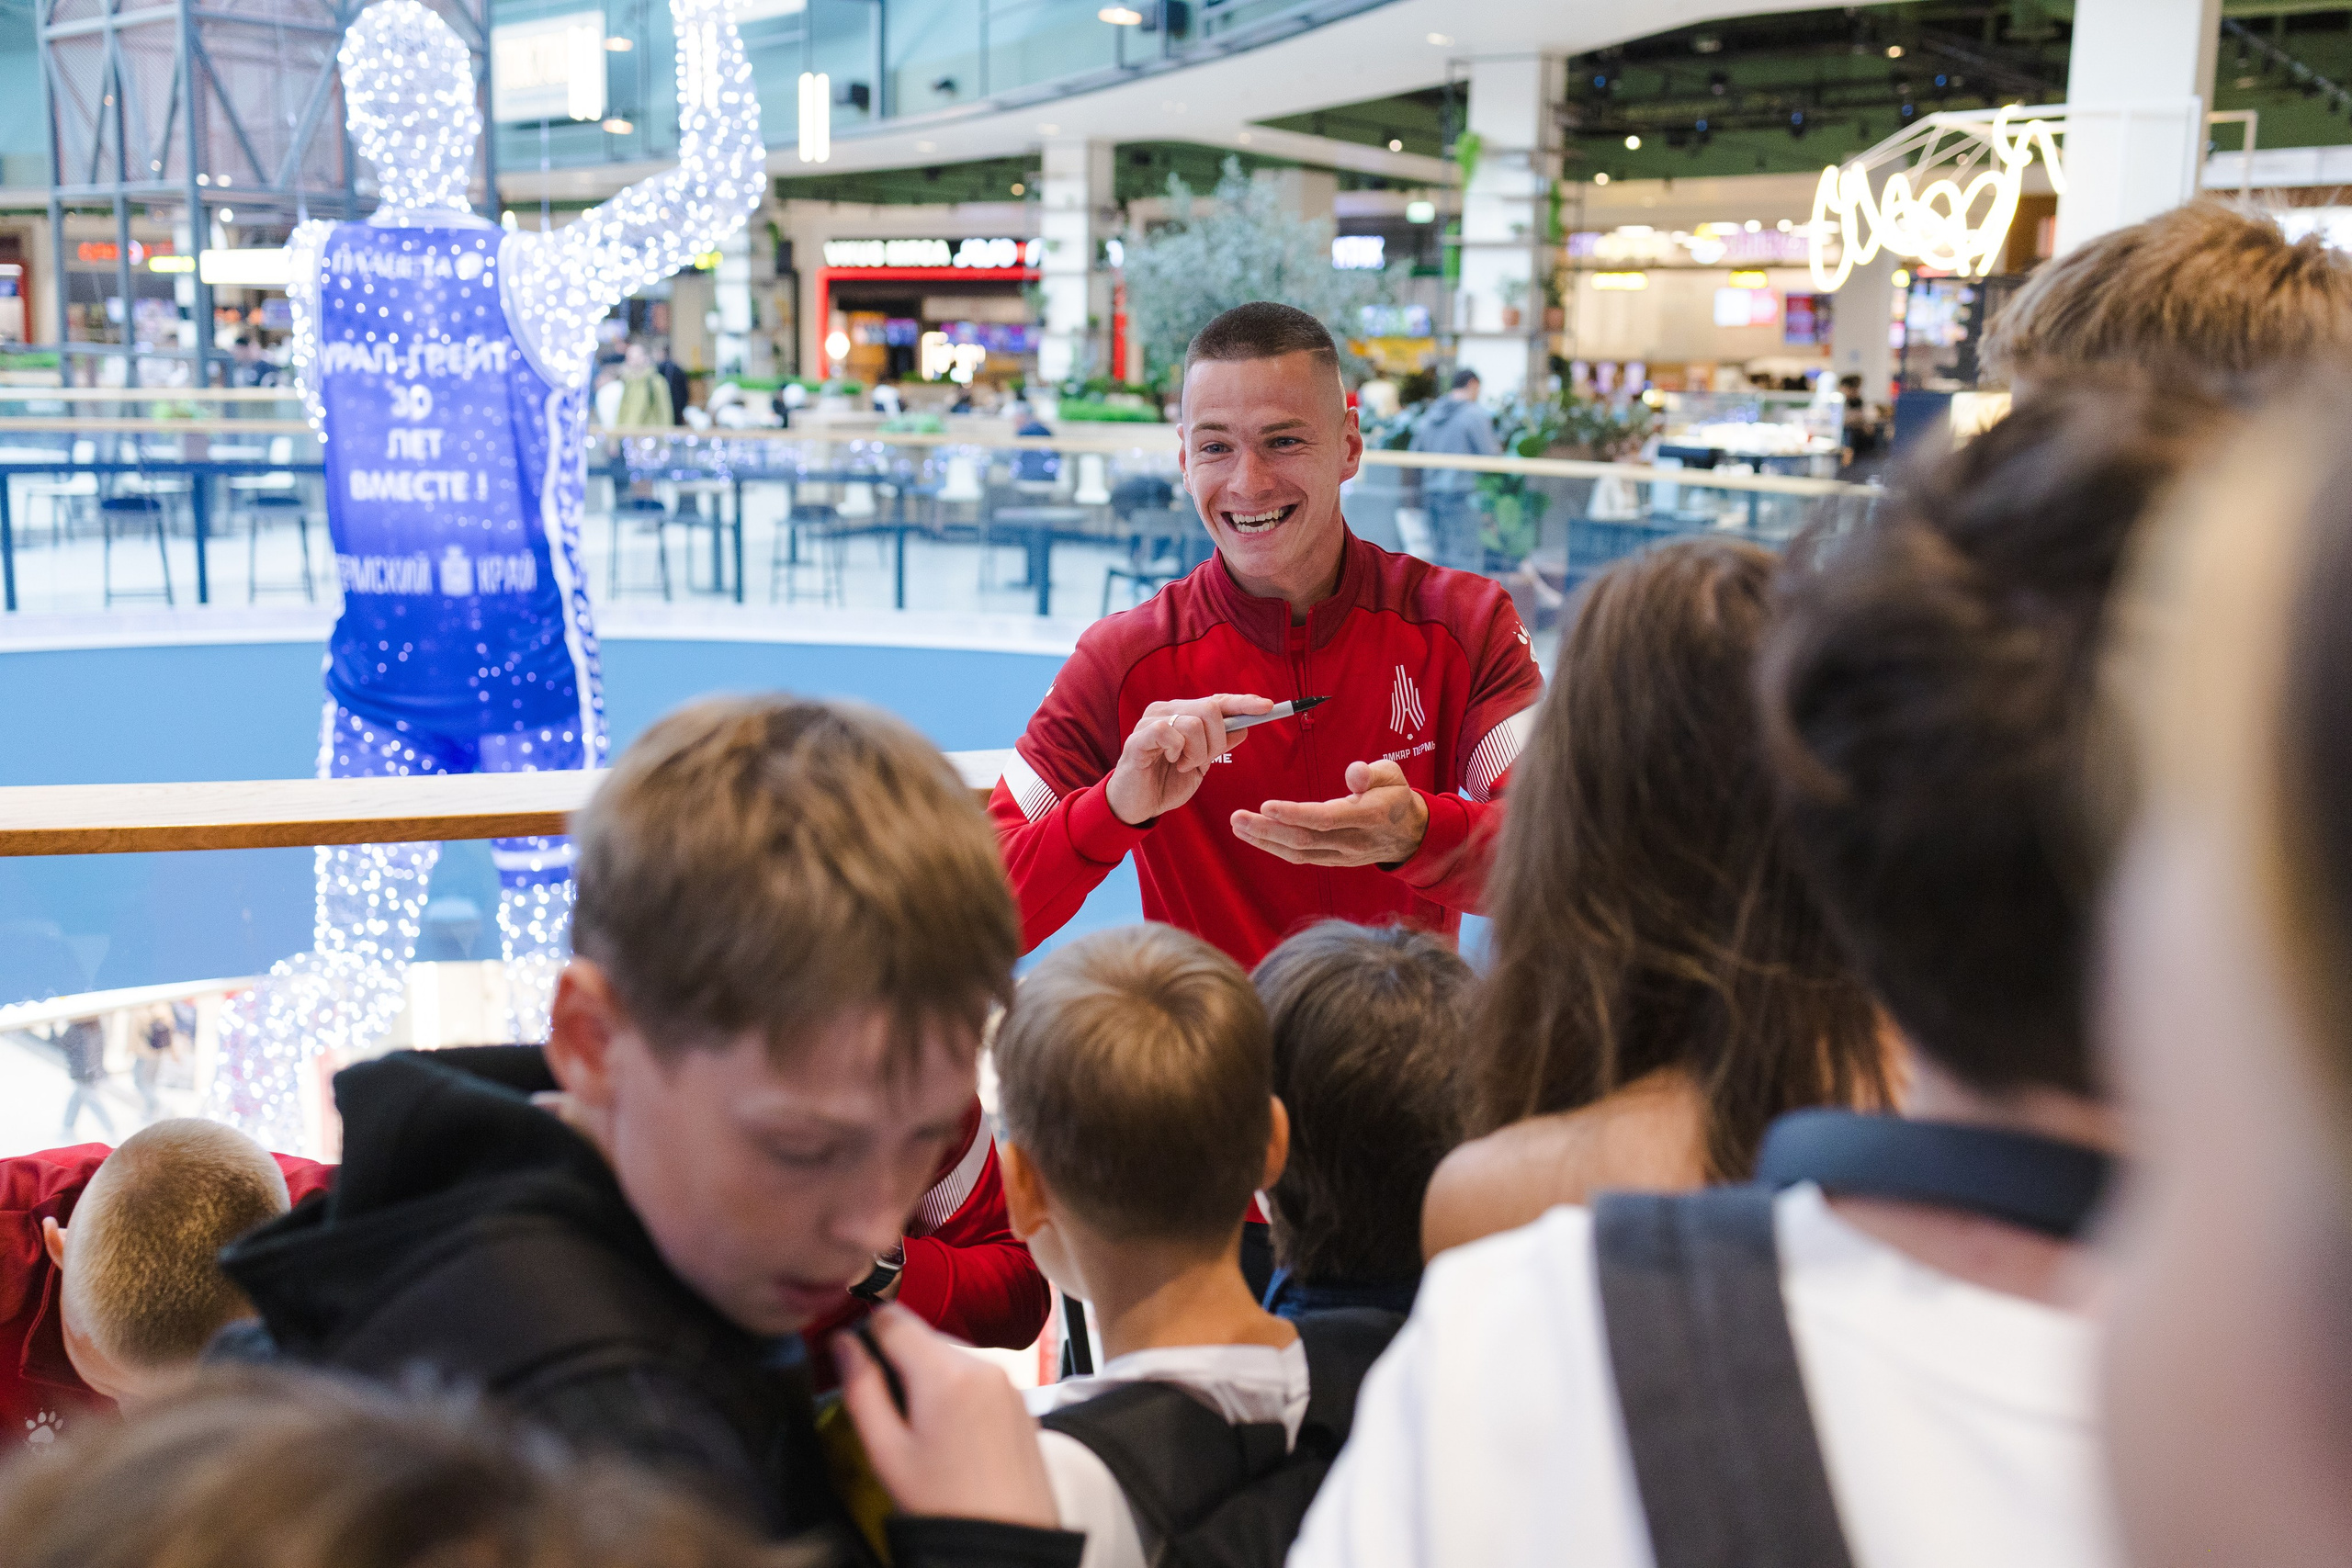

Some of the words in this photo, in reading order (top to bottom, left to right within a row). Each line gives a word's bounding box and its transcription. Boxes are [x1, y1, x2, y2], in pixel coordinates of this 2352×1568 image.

[390, 384, 434, 421] 30
[386, 428, 444, 459] ЛЕТ
[348, 469, 469, 502] ВМЕСТЕ
[476, 549, 537, 595] КРАЙ
[1413, 740, 1436, 757] ПЕРМЬ
